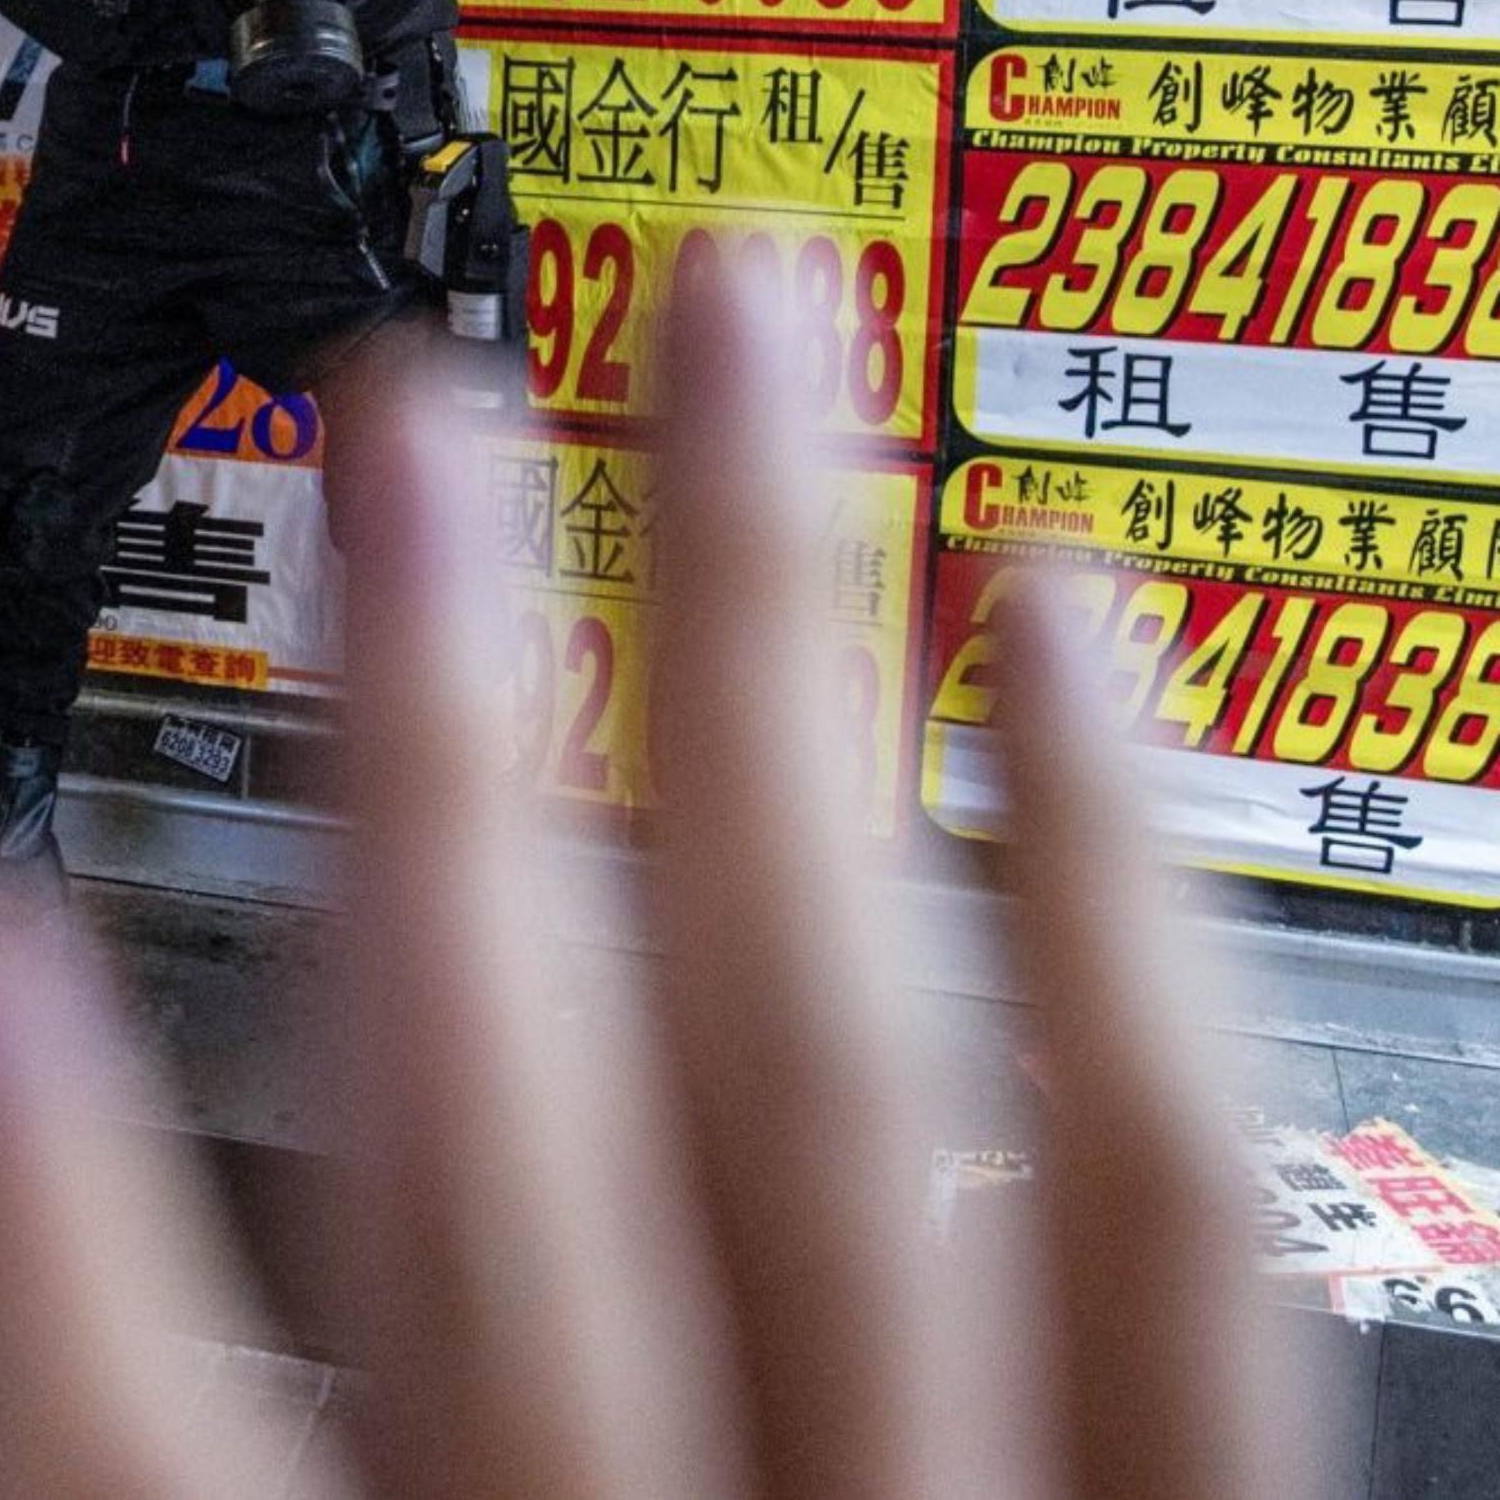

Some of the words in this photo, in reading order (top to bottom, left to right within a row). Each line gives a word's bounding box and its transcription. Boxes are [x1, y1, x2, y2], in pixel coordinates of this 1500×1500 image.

[501, 55, 741, 194] 國金行
[988, 52, 1122, 124] CHAMPION
[971, 129, 1121, 156] Champion
[1131, 136, 1267, 164] Property
[1276, 145, 1462, 170] Consultants
[960, 160, 1500, 358] 2384183
[1057, 344, 1193, 440] 租
[1338, 358, 1469, 462] 售
[1100, 549, 1236, 583] Property
[1243, 563, 1425, 603] Consultants
[1120, 476, 1500, 580] 創峰物業顧
[1298, 775, 1424, 876] 售
